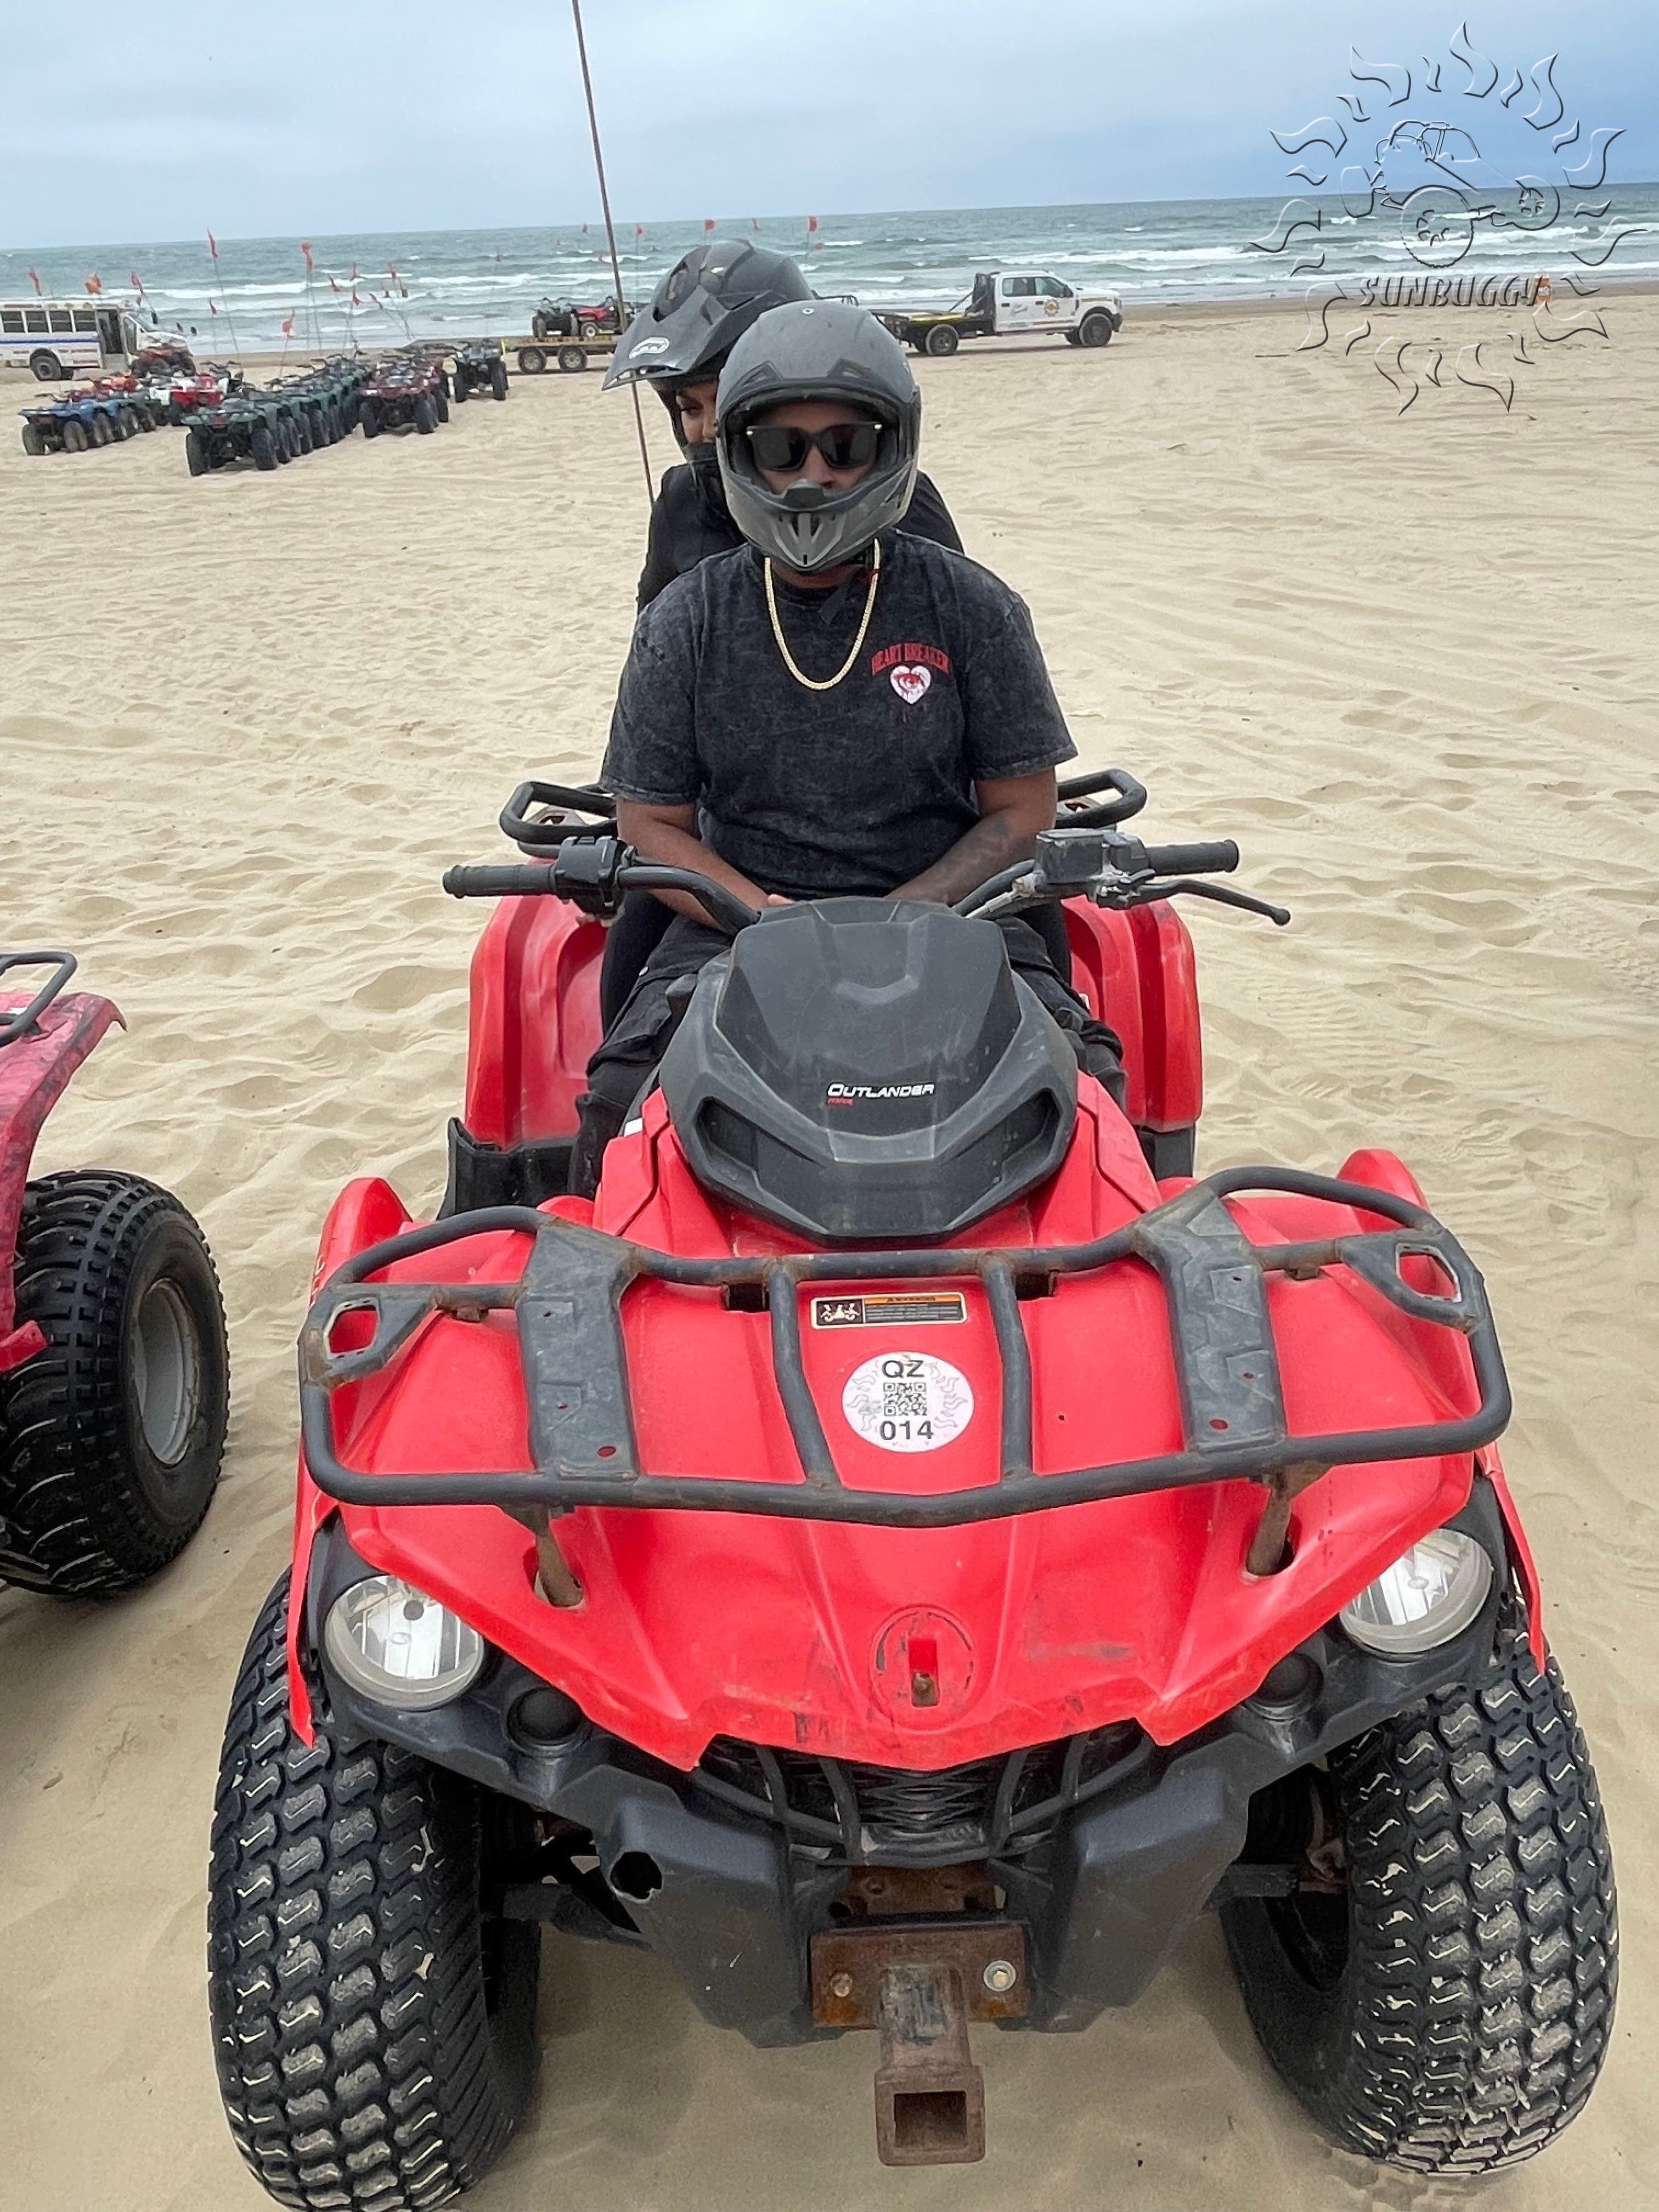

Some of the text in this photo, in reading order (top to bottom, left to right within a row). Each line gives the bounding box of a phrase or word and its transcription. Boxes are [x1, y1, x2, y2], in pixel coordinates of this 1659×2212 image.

[827, 1083, 935, 1097] OUTLANDER
[882, 1360, 925, 1378] QZ
[880, 1420, 934, 1440] 014
